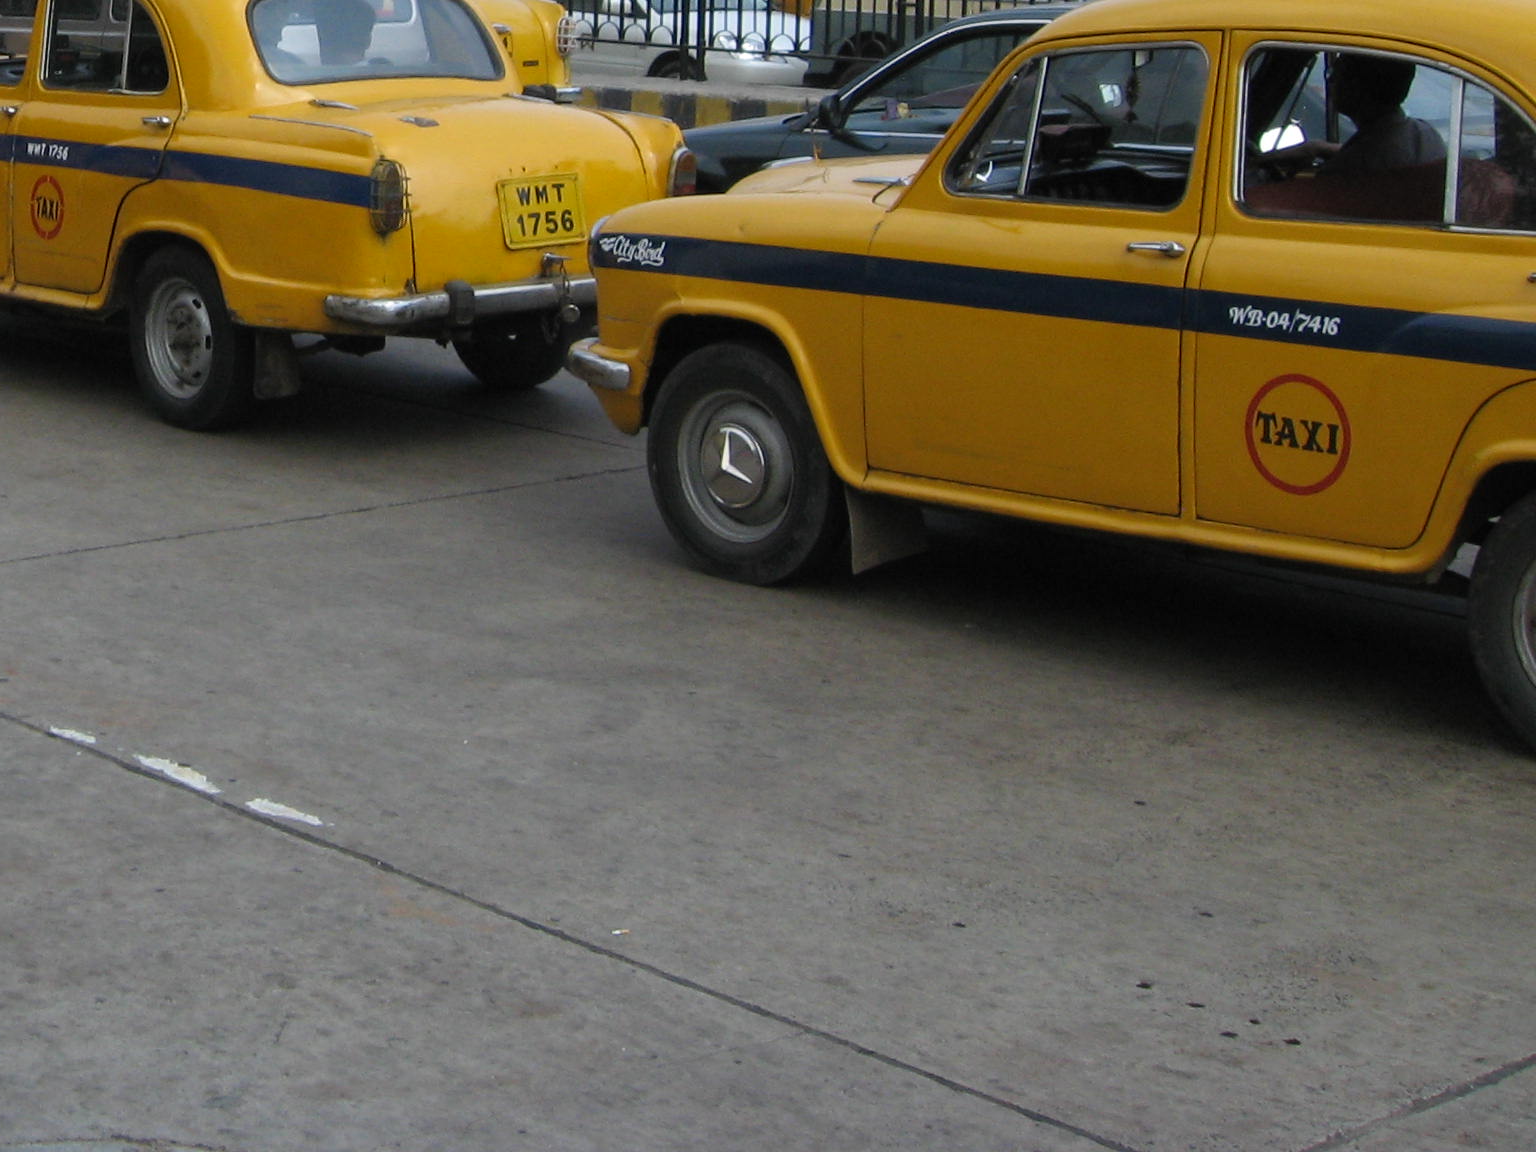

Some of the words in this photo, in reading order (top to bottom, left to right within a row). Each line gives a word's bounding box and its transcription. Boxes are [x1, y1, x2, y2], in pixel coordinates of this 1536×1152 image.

[27, 142, 47, 157] WMT
[48, 143, 69, 161] 1756
[36, 195, 59, 222] TAXI
[516, 183, 565, 207] WMT
[517, 209, 575, 238] 1756
[1255, 410, 1340, 456] TAXI
